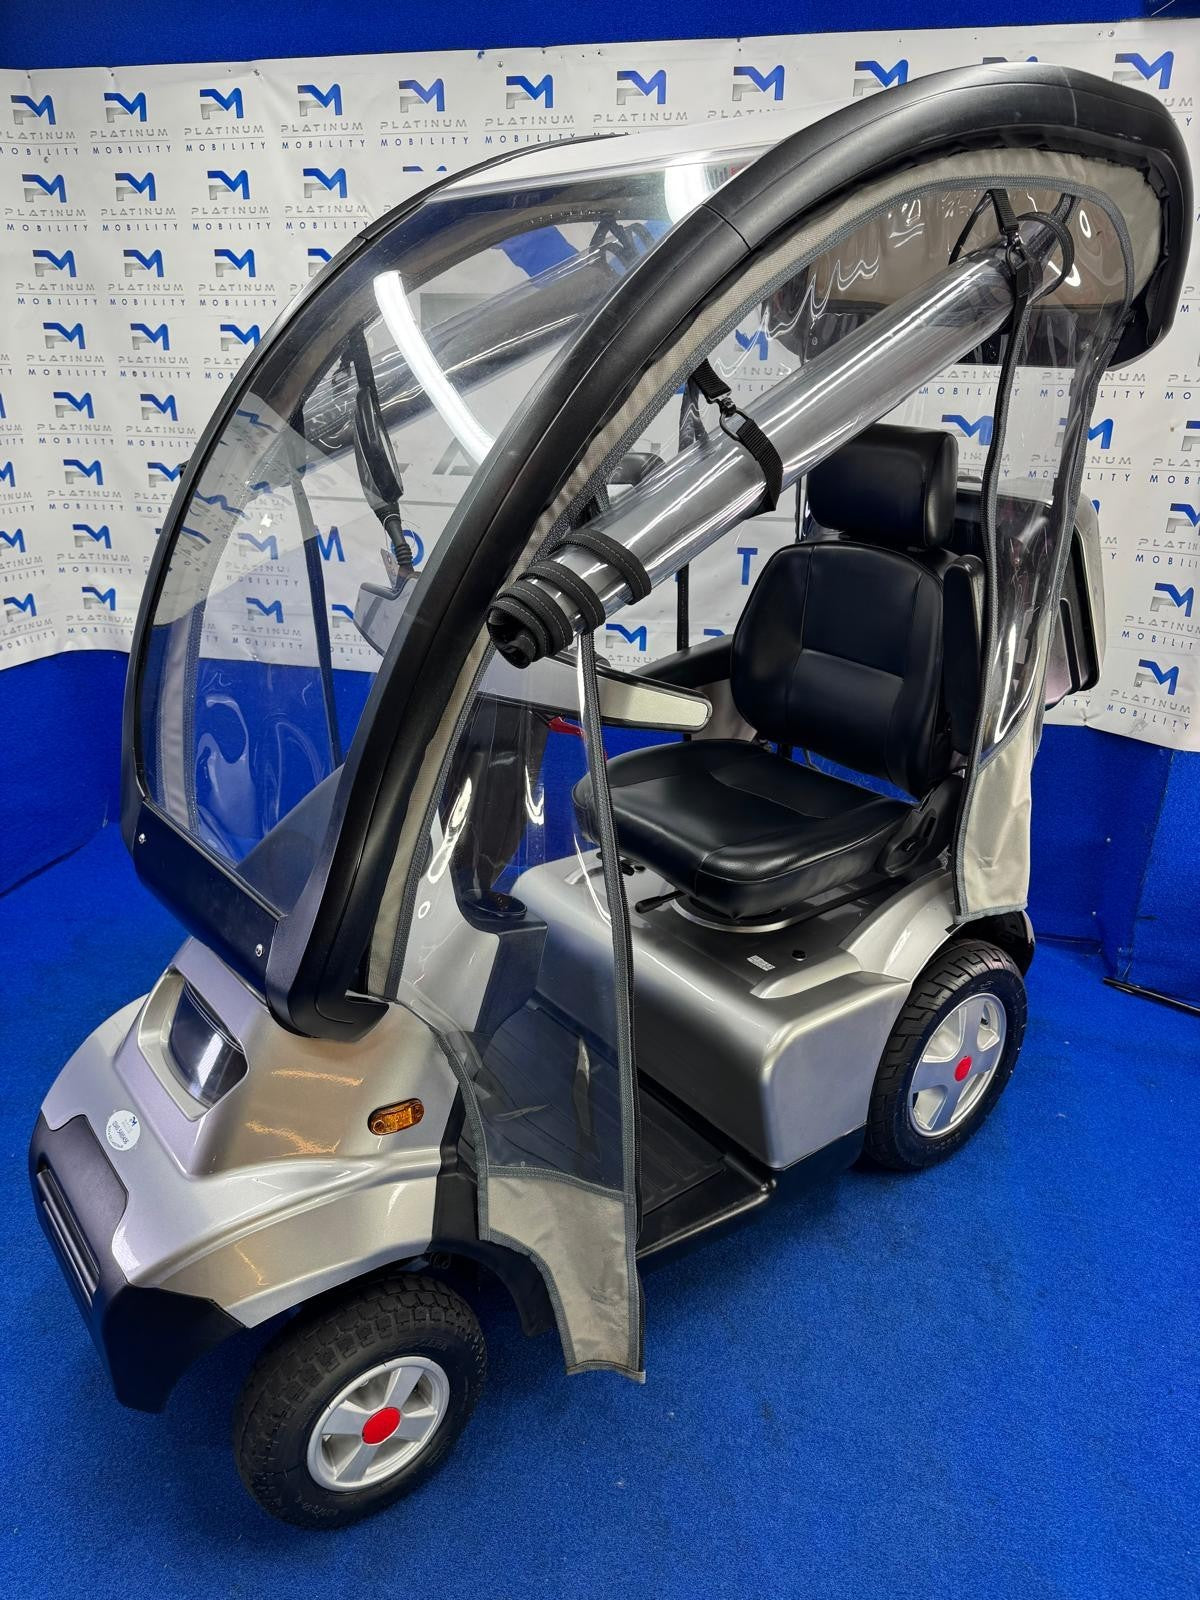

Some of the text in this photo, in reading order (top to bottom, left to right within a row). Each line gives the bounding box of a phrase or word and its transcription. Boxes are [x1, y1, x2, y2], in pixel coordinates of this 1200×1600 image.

[485, 115, 574, 126] PLATINUM
[593, 112, 688, 123] PLATINUM
[280, 122, 364, 133] PLATINUM
[380, 119, 468, 130] PLATINUM
[0, 130, 76, 140] LATINUM
[90, 128, 169, 138] PLATINUM
[184, 125, 264, 136] PLATINUM
[282, 139, 365, 149] MOBILITY
[380, 137, 469, 146] MOBILITY
[0, 147, 79, 156] OBILITY
[93, 145, 171, 154] MOBILITY
[186, 142, 265, 152] MOBILITY
[5, 207, 86, 217] PLATINUM
[101, 207, 176, 216] PLATINUM
[191, 205, 269, 215] PLATINUM
[284, 204, 368, 214] PLATINUM
[6, 223, 88, 232] MOBILITY
[102, 223, 179, 232] MOBILITY
[192, 222, 271, 231] MOBILITY
[285, 221, 368, 230] MOBILITY
[16, 282, 95, 291] PLATINUM
[108, 283, 184, 291] PLATINUM
[198, 283, 275, 292] PLATINUM
[17, 297, 98, 306] MOBILITY
[110, 298, 186, 306] MOBILITY
[199, 298, 277, 307] MOBILITY
[26, 354, 104, 363] PLATINUM
[118, 356, 189, 364] PLATINUM
[28, 368, 107, 377] MOBILITY
[120, 370, 191, 379] MOBILITY
[37, 423, 112, 431] PLATINUM
[126, 425, 196, 434] PLATINUM
[39, 437, 114, 445] MOBILITY
[47, 490, 122, 498] PLATINUM
[49, 503, 124, 511] MOBILITY
[57, 553, 130, 562] PLATINUM
[58, 566, 132, 575] MOBILITY
[66, 615, 133, 623] PLATINUM
[0, 617, 53, 636] LATINUM
[232, 624, 301, 636] PLATINUM
[232, 637, 303, 649] MOBILITY
[1110, 689, 1190, 714] PLATINUM
[1106, 704, 1189, 730] MOBILITY
